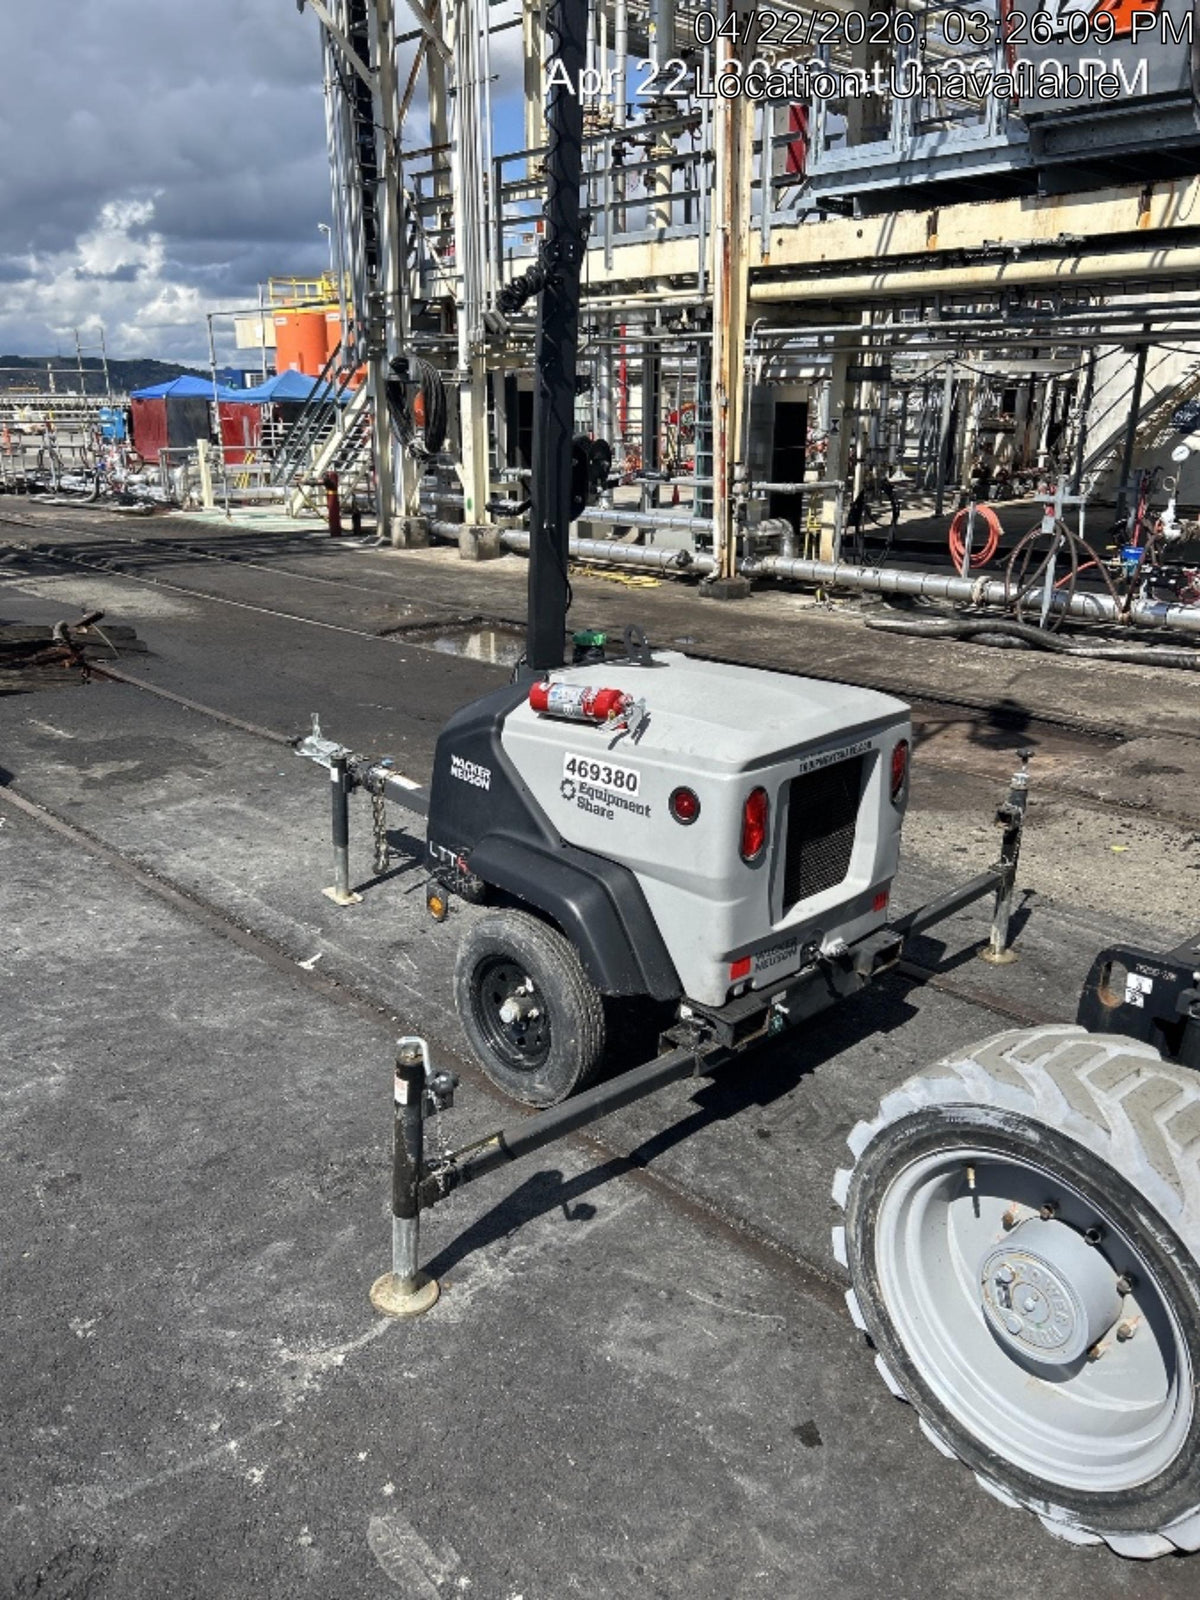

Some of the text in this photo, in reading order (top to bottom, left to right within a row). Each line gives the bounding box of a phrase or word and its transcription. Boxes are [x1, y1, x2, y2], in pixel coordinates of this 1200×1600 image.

[450, 754, 492, 777] WACKER
[450, 765, 491, 792] NEUSON
[565, 757, 639, 792] 469380
[577, 796, 615, 821] Share
[578, 782, 651, 819] Equipment
